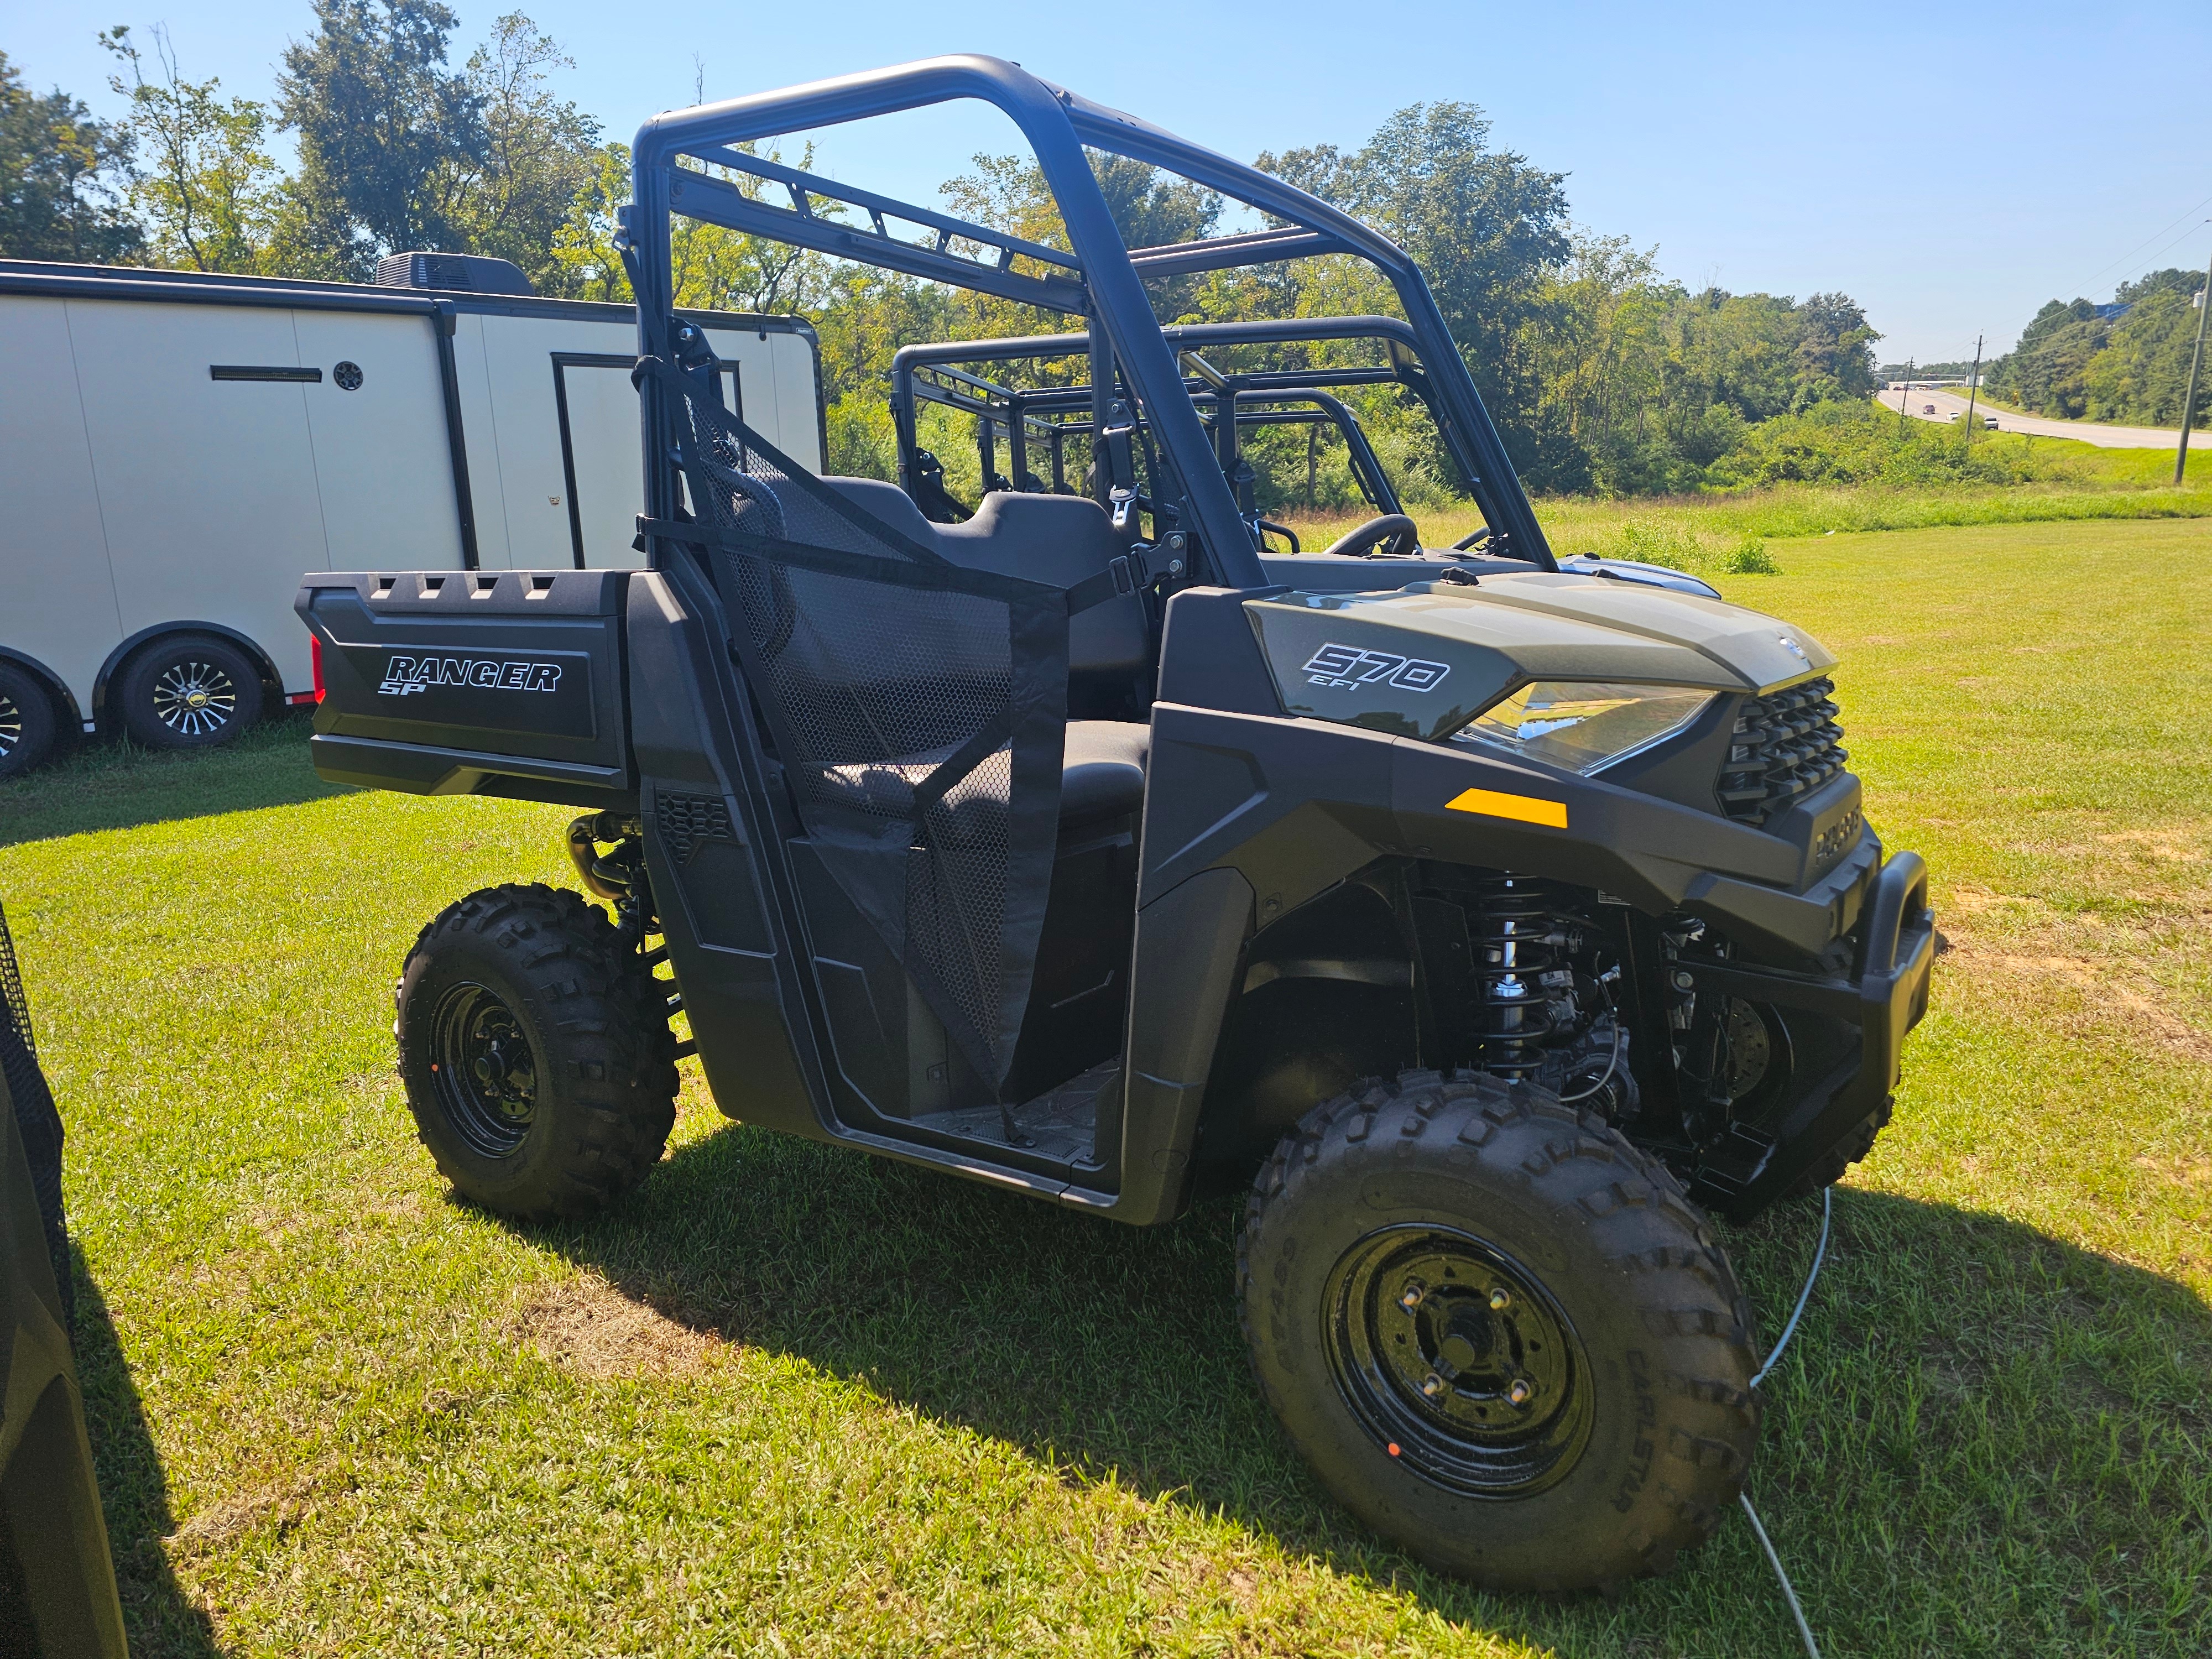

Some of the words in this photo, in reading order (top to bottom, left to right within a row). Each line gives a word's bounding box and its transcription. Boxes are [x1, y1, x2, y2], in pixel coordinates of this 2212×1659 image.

[386, 656, 562, 692] RANGER
[1302, 643, 1451, 692] 570
[378, 681, 427, 696] SP
[1308, 674, 1360, 691] EFI
